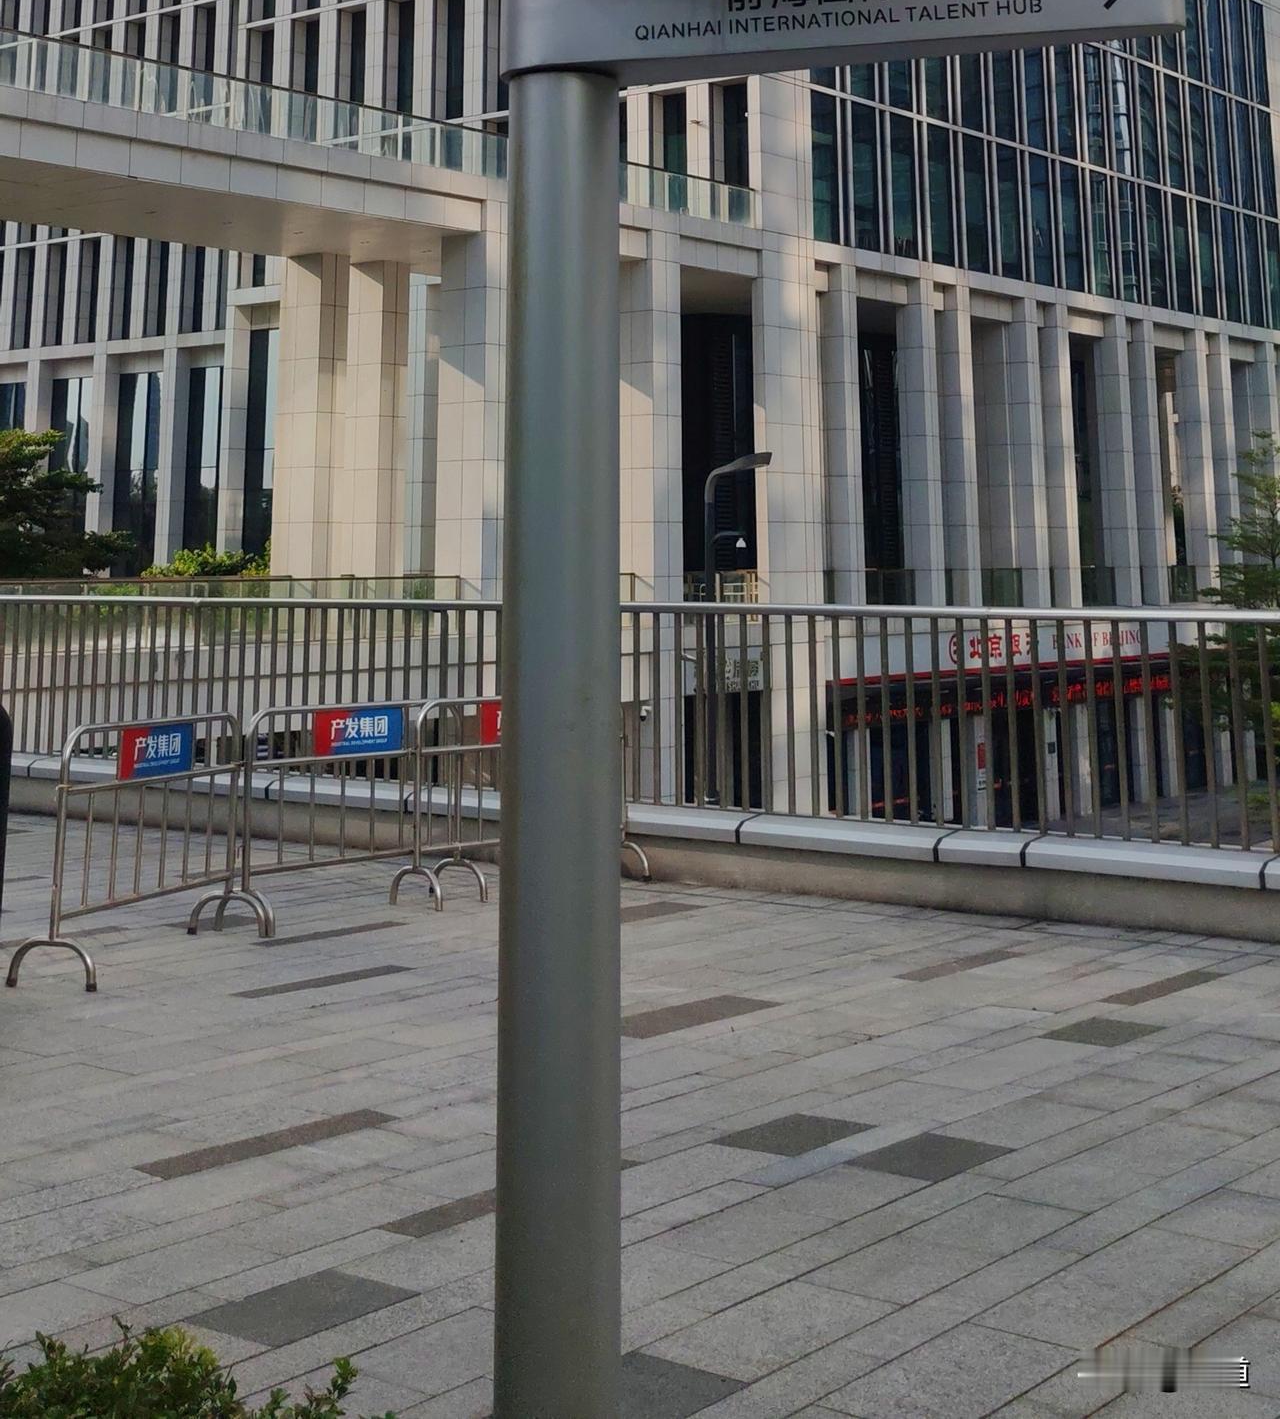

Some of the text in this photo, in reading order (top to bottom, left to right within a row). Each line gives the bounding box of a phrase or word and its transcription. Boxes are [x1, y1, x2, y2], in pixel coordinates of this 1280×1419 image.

[635, 20, 722, 41] QIANHAI
[729, 7, 900, 35] INTERNATIONAL
[905, 1, 989, 22] TALENT
[331, 715, 388, 740] 产发集团
[134, 733, 181, 761] 产发集团
